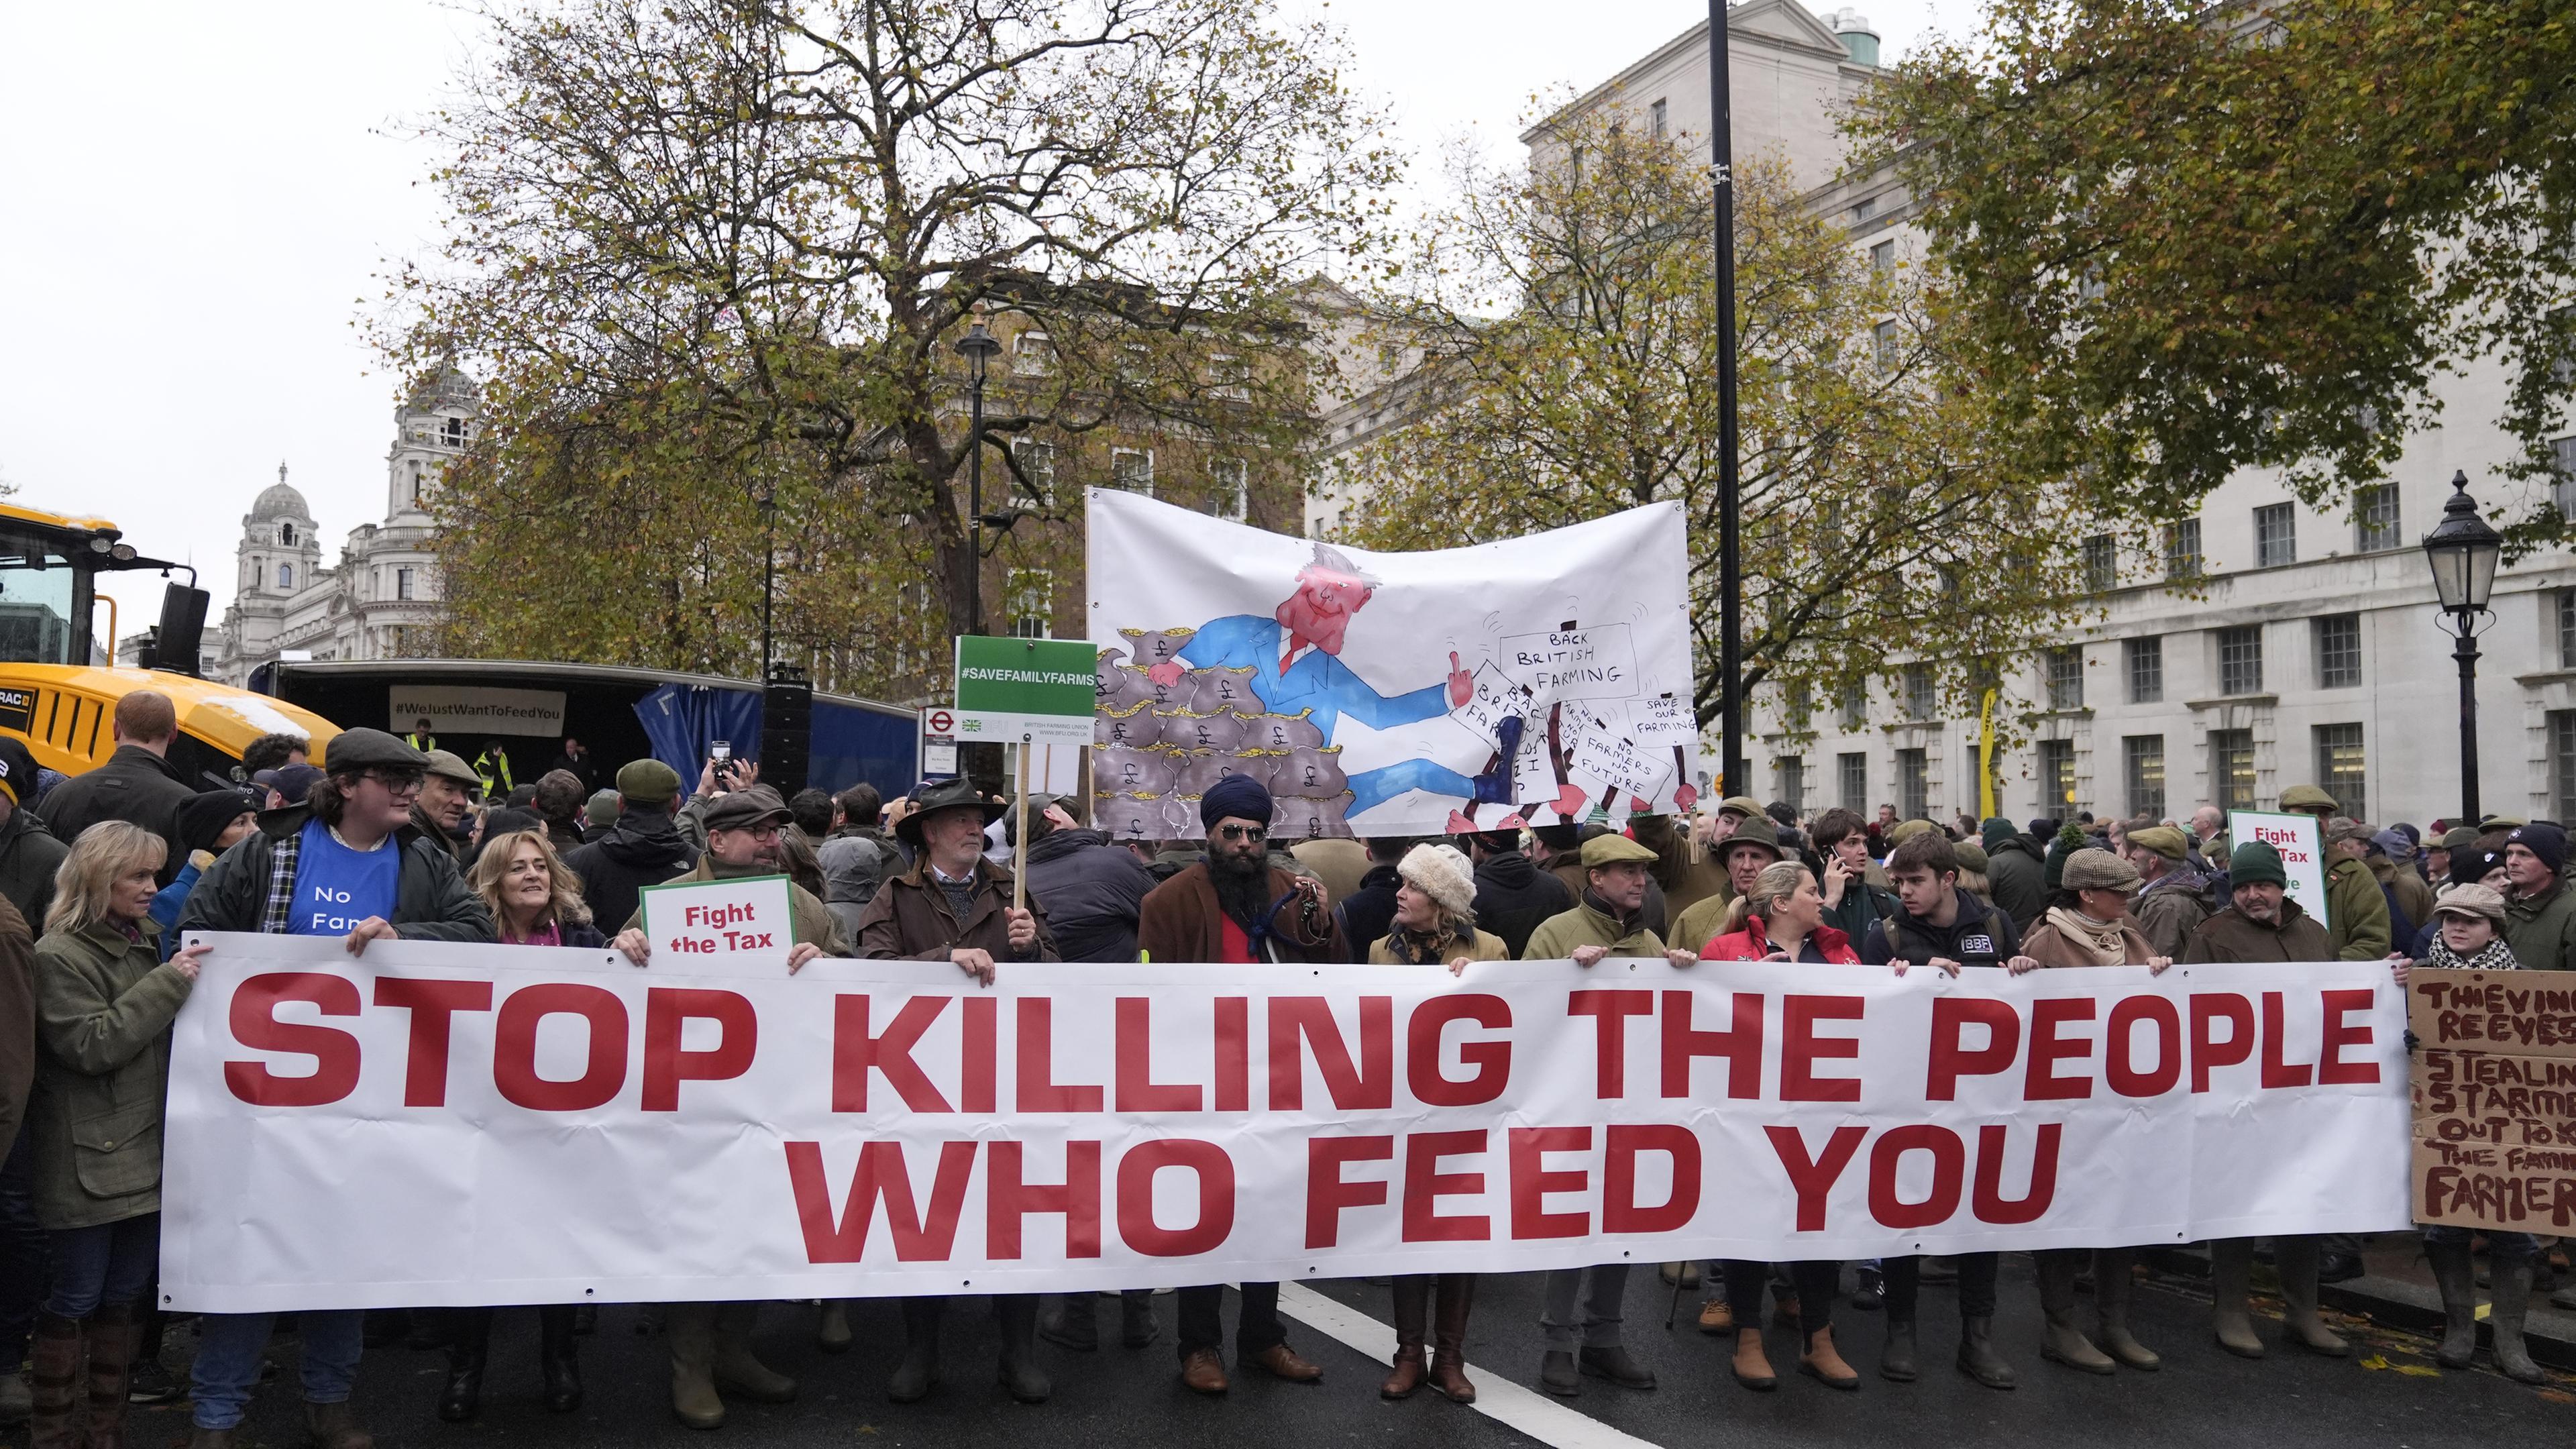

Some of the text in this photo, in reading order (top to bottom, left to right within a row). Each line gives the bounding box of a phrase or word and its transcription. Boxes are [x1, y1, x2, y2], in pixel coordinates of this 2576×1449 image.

[1550, 633, 1588, 646] BACK
[1517, 646, 1594, 665] BRITISH
[961, 667, 1095, 686] #SAVEFAMILYFARMS
[1537, 666, 1624, 689] FARMING
[396, 703, 559, 720] #WeJustWantToFeedYou
[1647, 698, 1678, 709] SAVE
[1656, 708, 1678, 718] OUR
[1637, 719, 1697, 734] FARMING
[1587, 737, 1652, 775] FARMERS
[1582, 758, 1644, 792] FUTURE
[2255, 827, 2297, 846] Fight
[315, 886, 351, 904] No
[685, 902, 755, 929] Fight
[670, 931, 773, 953] the Tax
[1965, 938, 1988, 949] BBF
[2417, 975, 2576, 1014] THIEVIN
[2438, 1010, 2576, 1046] REEVES
[225, 972, 2381, 1113] STOP KILLING THE PEOPLE
[2423, 1138, 2498, 1167] THE
[784, 1122, 2063, 1264] WHO FEED YOU
